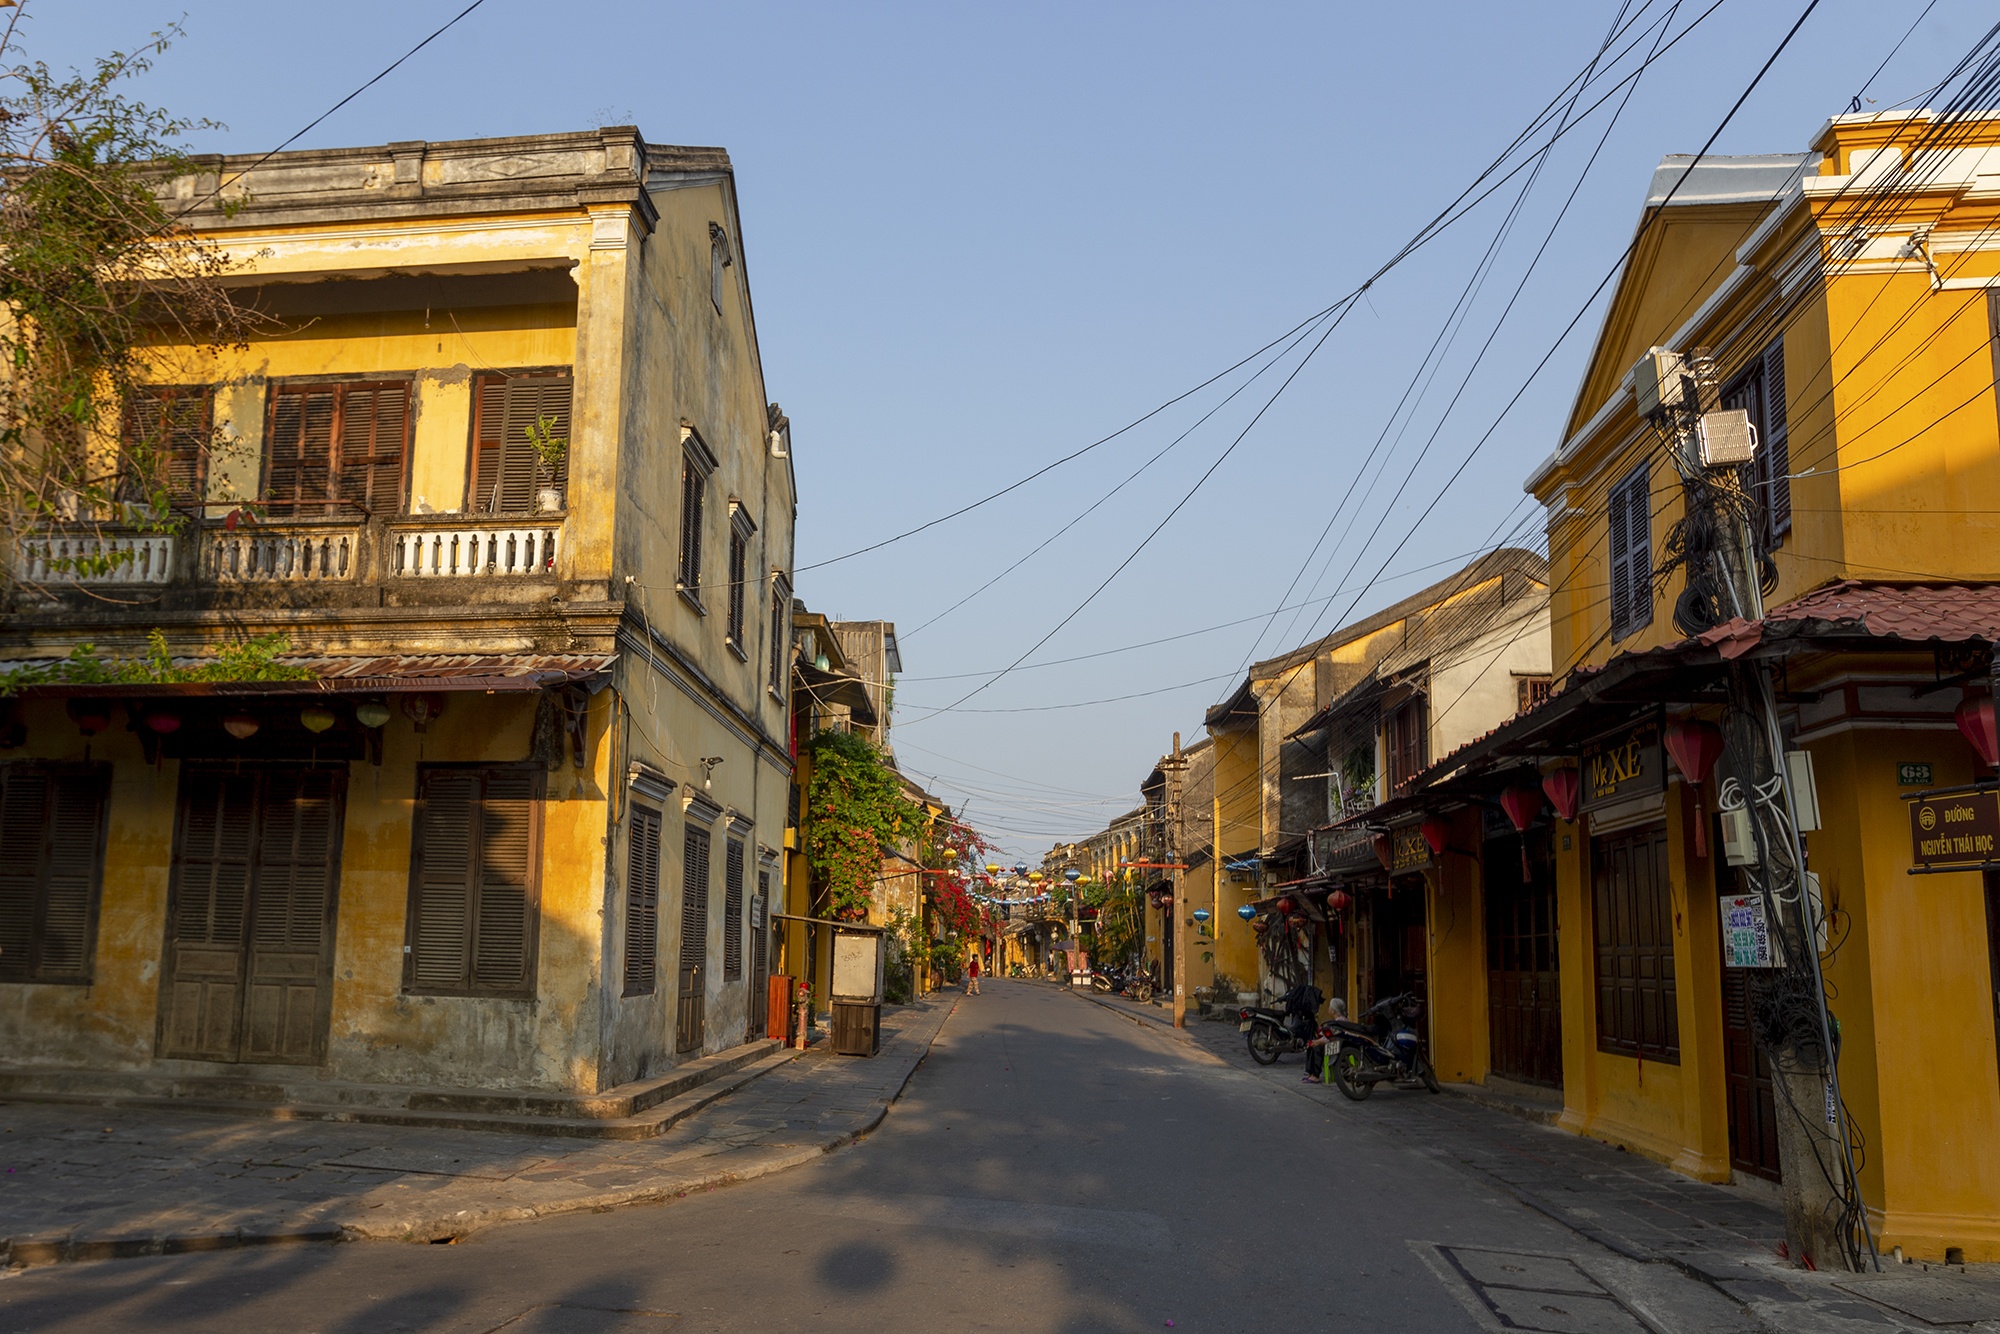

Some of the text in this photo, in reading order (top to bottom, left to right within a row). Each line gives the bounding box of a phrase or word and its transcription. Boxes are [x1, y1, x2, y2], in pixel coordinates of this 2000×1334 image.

[1608, 735, 1641, 785] XÊ
[1901, 765, 1930, 778] 63
[1944, 804, 1975, 823] ĐƯỜNG
[1920, 832, 1994, 856] NGUYỄN THÁI HỌC
